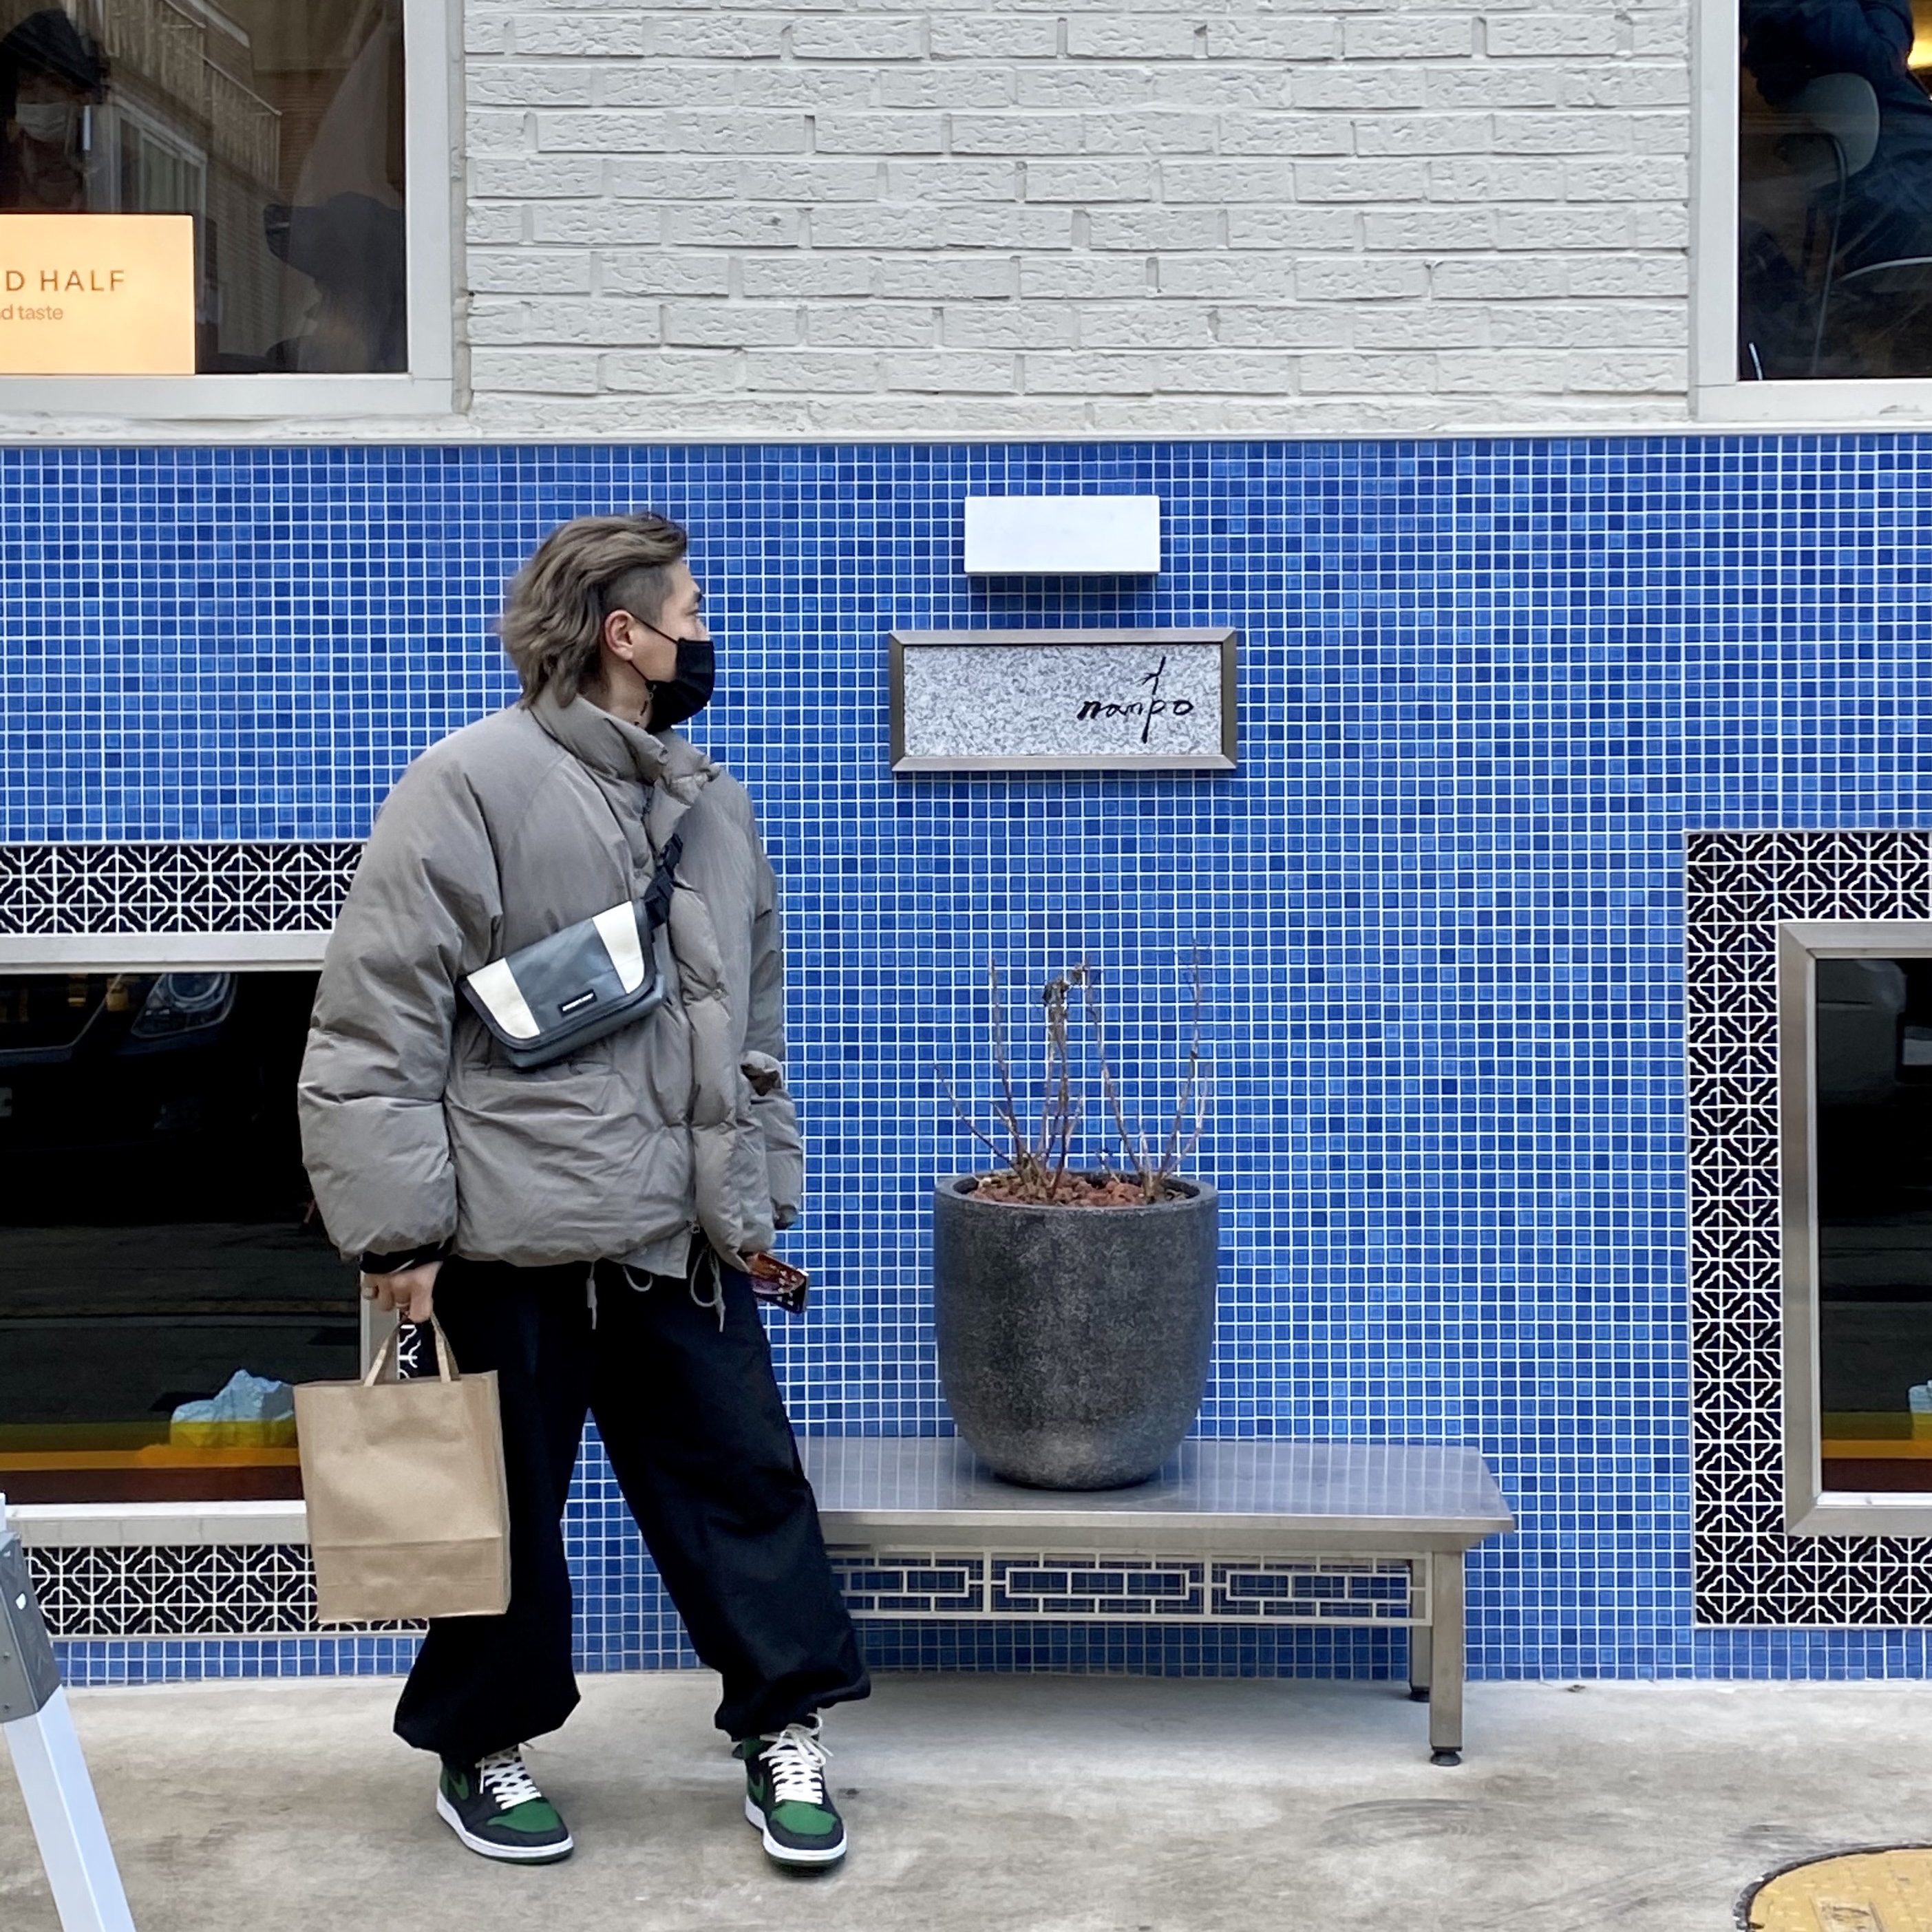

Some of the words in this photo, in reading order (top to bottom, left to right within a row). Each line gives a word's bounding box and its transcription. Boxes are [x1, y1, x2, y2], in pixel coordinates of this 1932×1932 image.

[40, 269, 125, 292] HALF
[0, 304, 13, 320] d
[17, 305, 63, 320] taste
